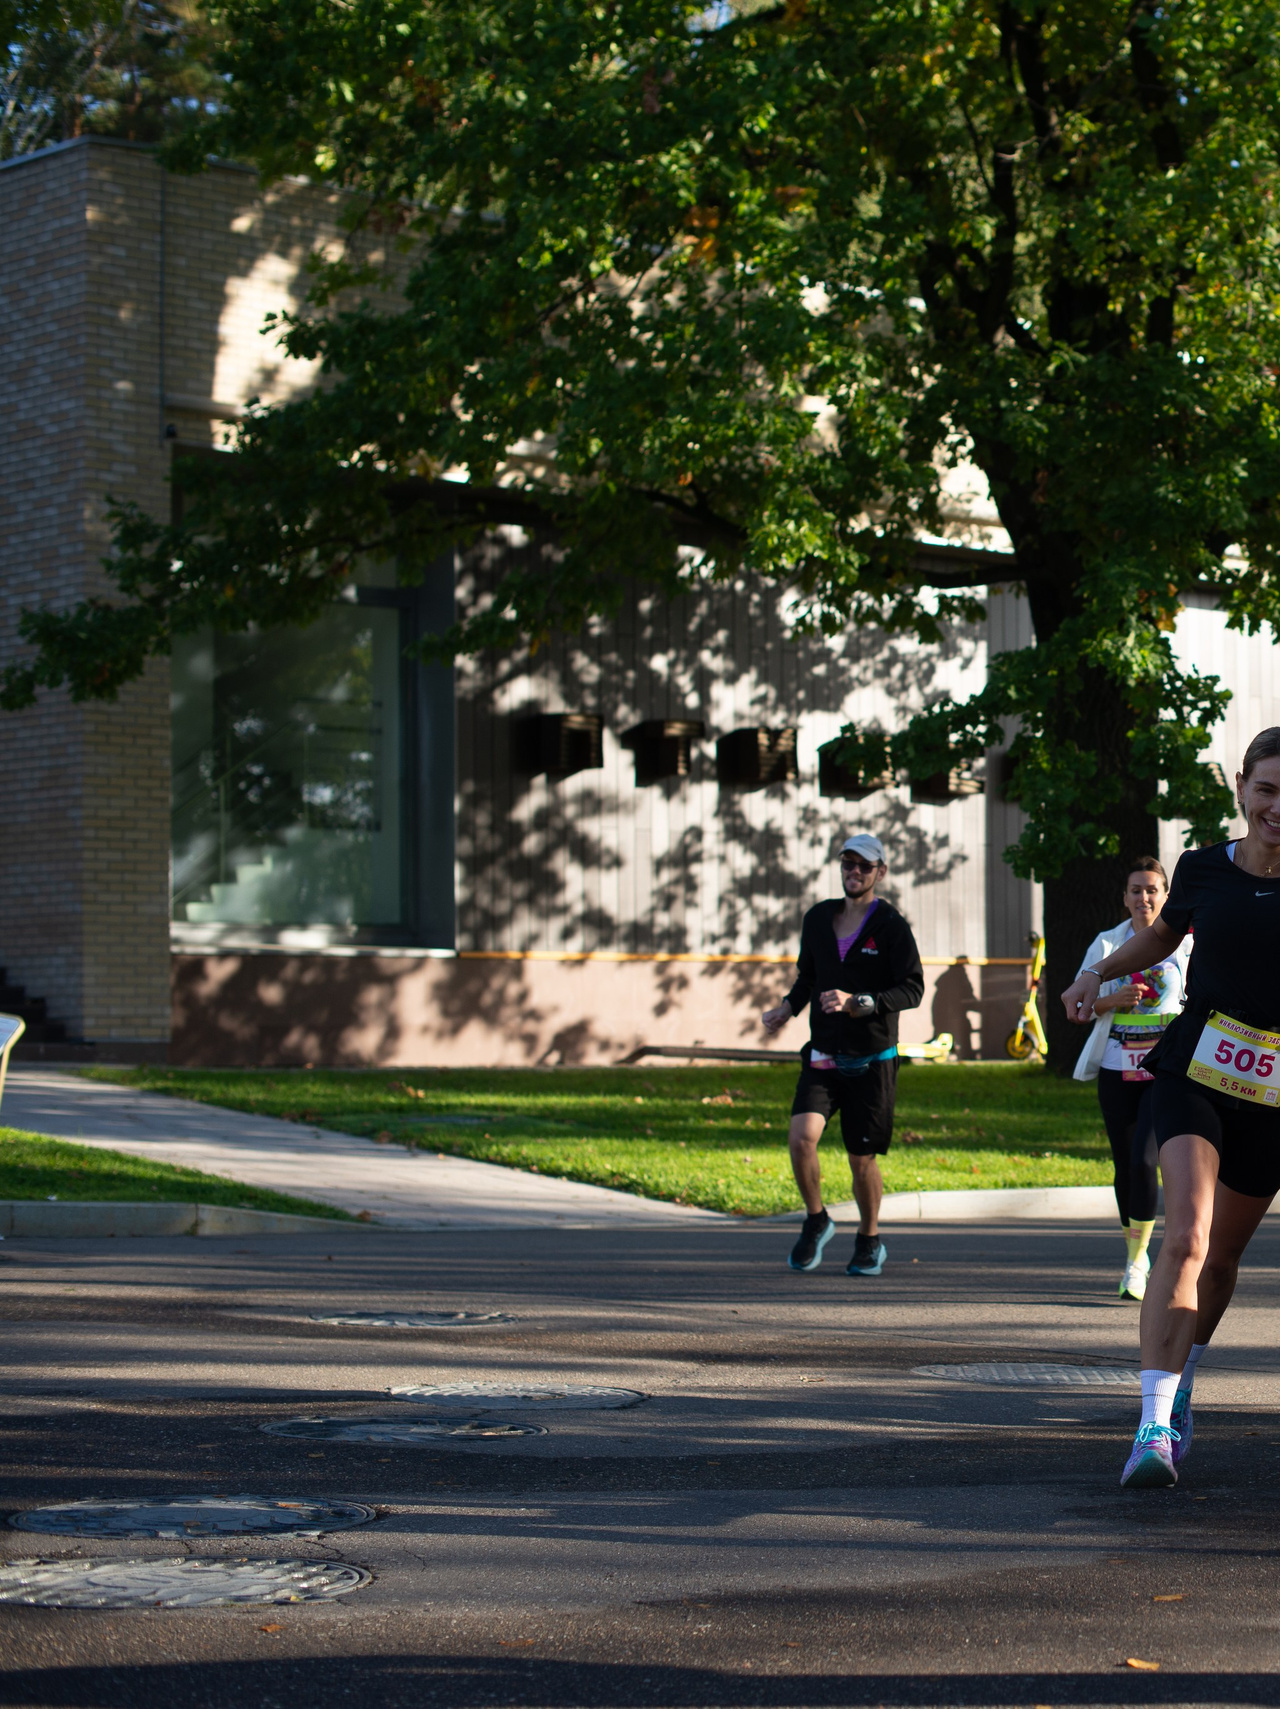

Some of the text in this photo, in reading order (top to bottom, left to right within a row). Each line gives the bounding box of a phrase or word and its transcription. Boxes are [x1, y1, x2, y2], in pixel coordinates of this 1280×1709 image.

[1218, 1018, 1268, 1042] ИНКЛЮЗИВНЫЙ
[1214, 1039, 1276, 1078] 505
[1219, 1077, 1239, 1092] 5,5
